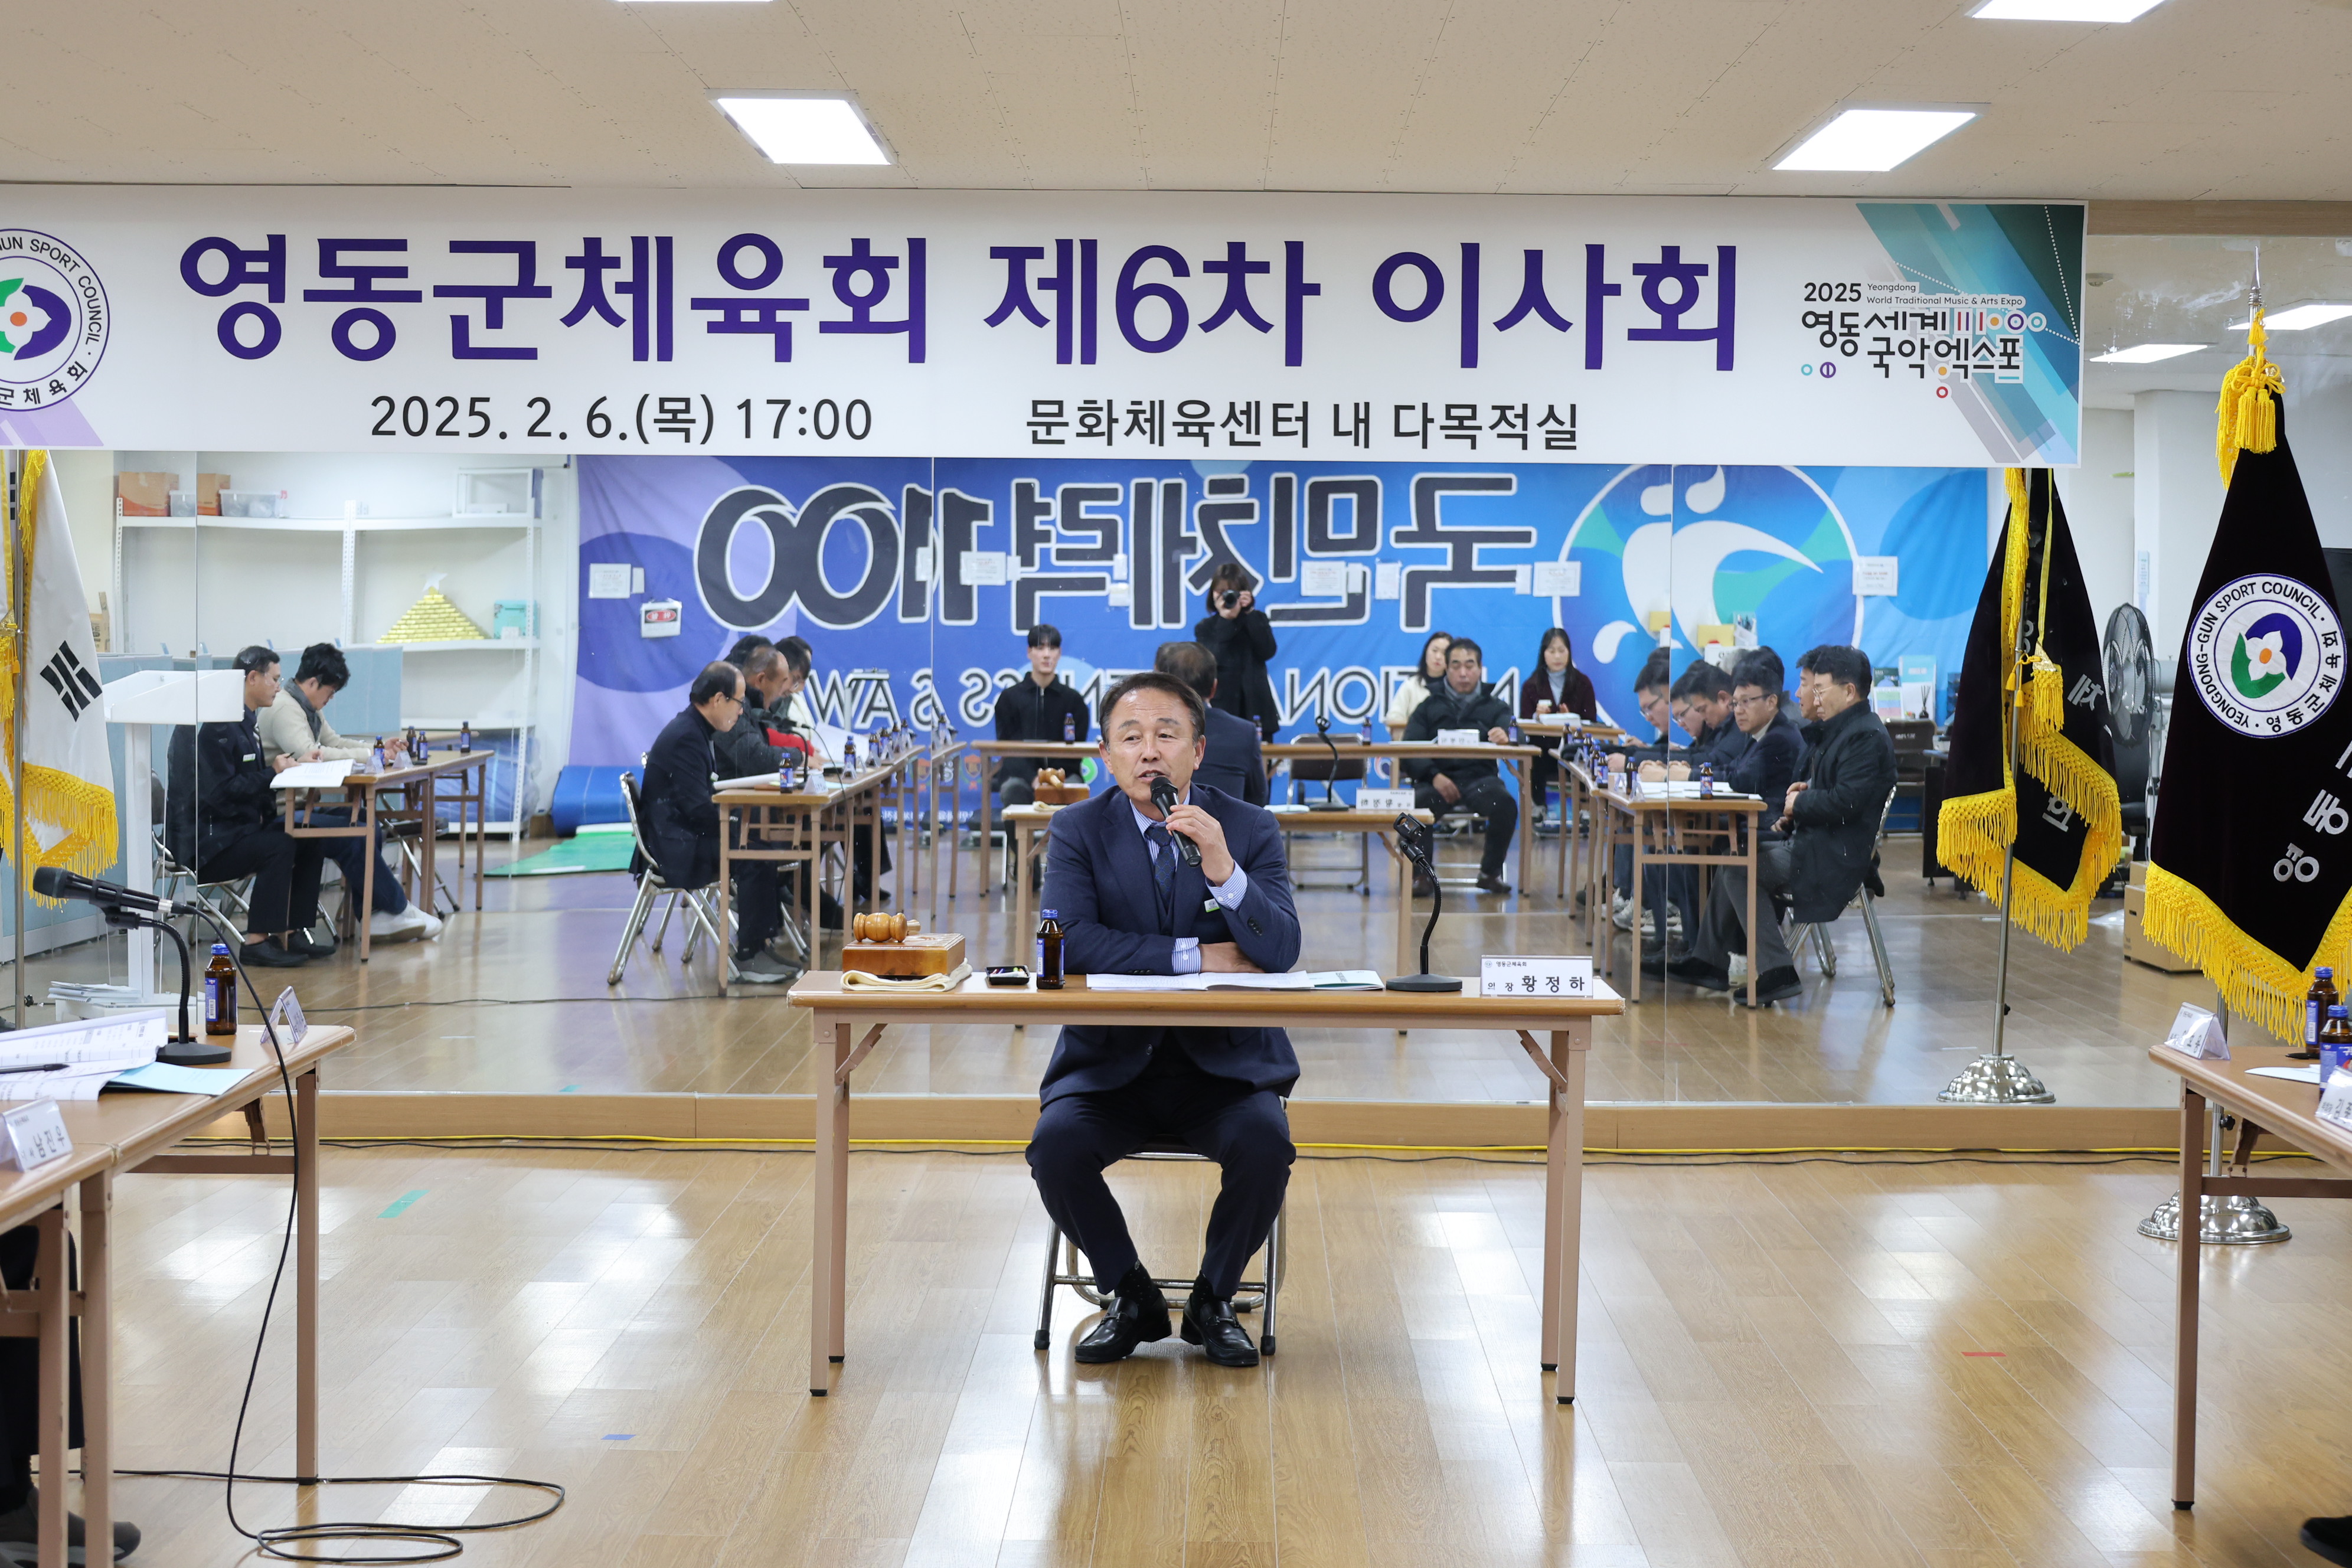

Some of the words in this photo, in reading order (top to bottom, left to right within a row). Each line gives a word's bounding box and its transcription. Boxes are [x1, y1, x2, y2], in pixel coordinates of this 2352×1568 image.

[30, 238, 81, 273] SPORT
[78, 276, 102, 345] COUNCIL
[180, 232, 927, 363] 영동군체육회
[983, 239, 1321, 367] 제6차
[1371, 242, 1737, 371] 이사회
[1804, 282, 1861, 302] 2025
[1867, 283, 1916, 292] Yeongdong
[1867, 296, 1892, 305] World
[1895, 296, 1941, 305] Traditional
[1944, 297, 1969, 305] Music
[2001, 298, 2023, 307] Expo
[1801, 310, 1946, 357] 영동세계
[1867, 337, 2020, 380] 국악엑스포
[371, 395, 508, 441] 2025.
[527, 397, 568, 441] 2.
[736, 398, 872, 441] 17:00
[1026, 399, 1309, 448] 문화체육센터
[1333, 401, 1370, 449] 내
[1394, 403, 1577, 450] 다목적실
[2215, 582, 2257, 613] SPORT
[2262, 581, 2322, 619] COUNCIL
[2196, 612, 2249, 728] YEONGDONG-GUN
[2266, 630, 2342, 733] 영동군체육회
